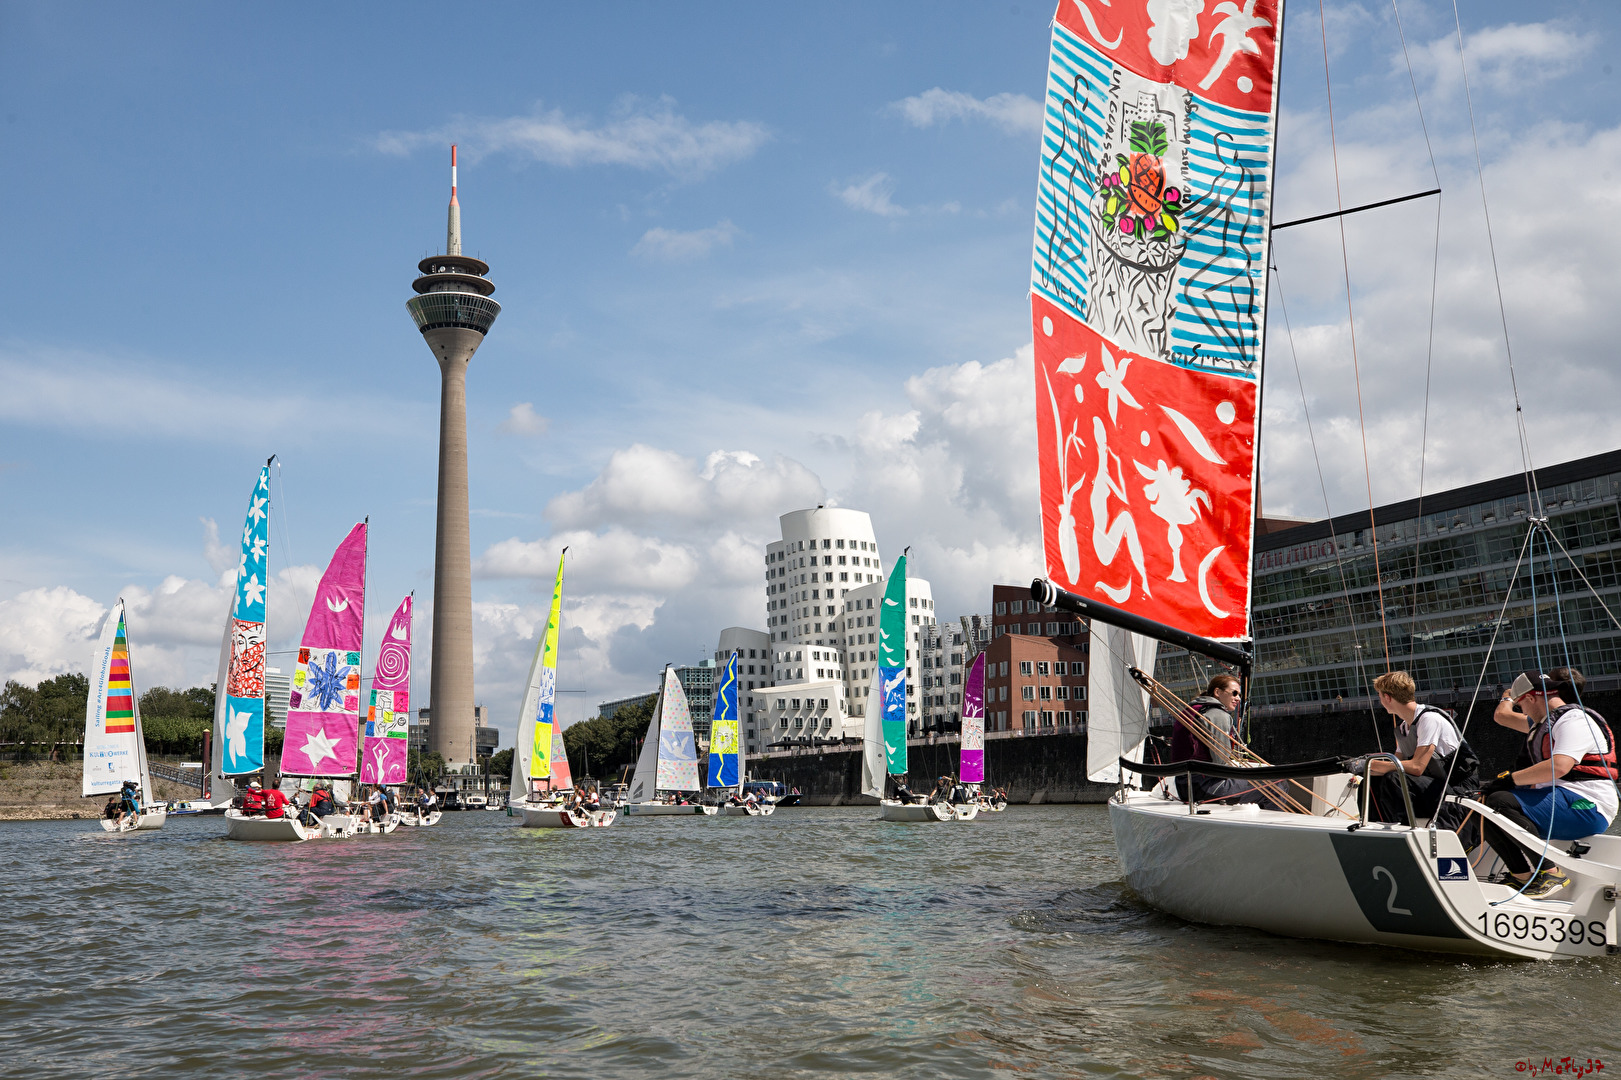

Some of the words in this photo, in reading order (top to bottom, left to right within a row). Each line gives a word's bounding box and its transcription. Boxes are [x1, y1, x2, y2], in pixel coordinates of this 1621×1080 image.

[1109, 70, 1121, 98] UN
[1103, 101, 1118, 150] GOALS
[1179, 89, 1198, 145] hunger
[1181, 148, 1191, 182] more
[1181, 186, 1191, 204] no
[1041, 268, 1089, 322] UNESCO
[97, 646, 111, 704] #Art4GlobalGoals
[1372, 865, 1413, 916] 2
[1477, 911, 1607, 947] 169539S
